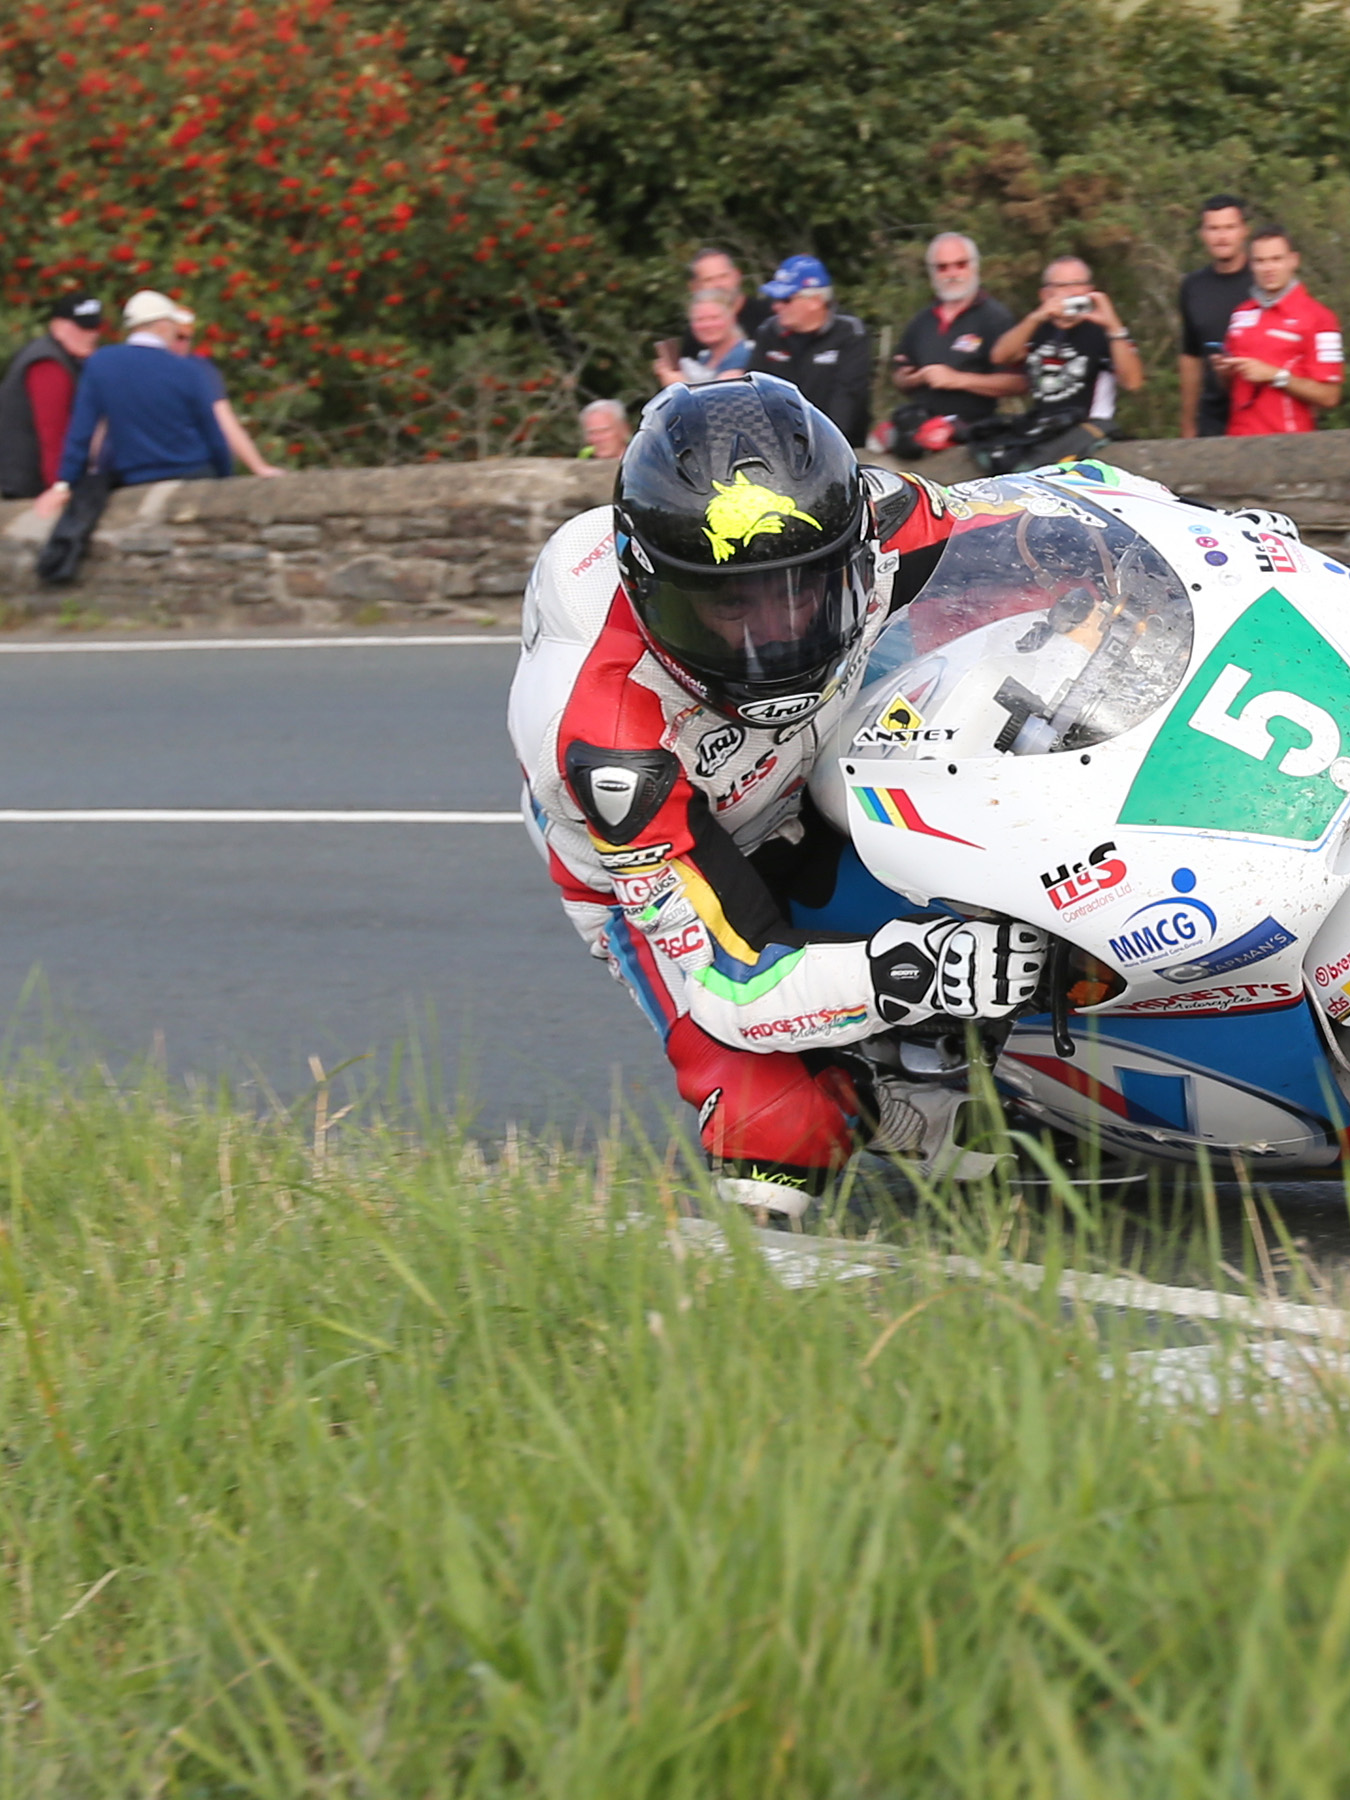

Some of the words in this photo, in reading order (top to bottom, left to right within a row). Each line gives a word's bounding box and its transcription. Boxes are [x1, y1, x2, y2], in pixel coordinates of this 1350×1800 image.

[745, 696, 812, 718] Arai
[1188, 662, 1341, 777] 5
[857, 728, 960, 742] ANSTEY
[1040, 841, 1127, 911] H&S
[1062, 892, 1115, 923] Contractors
[1114, 882, 1135, 898] Ltd.
[1108, 912, 1196, 962] MMCG
[1114, 983, 1292, 1012] PADGETT'S
[1327, 995, 1350, 1016] sbs
[739, 1008, 831, 1040] PADGETT'S
